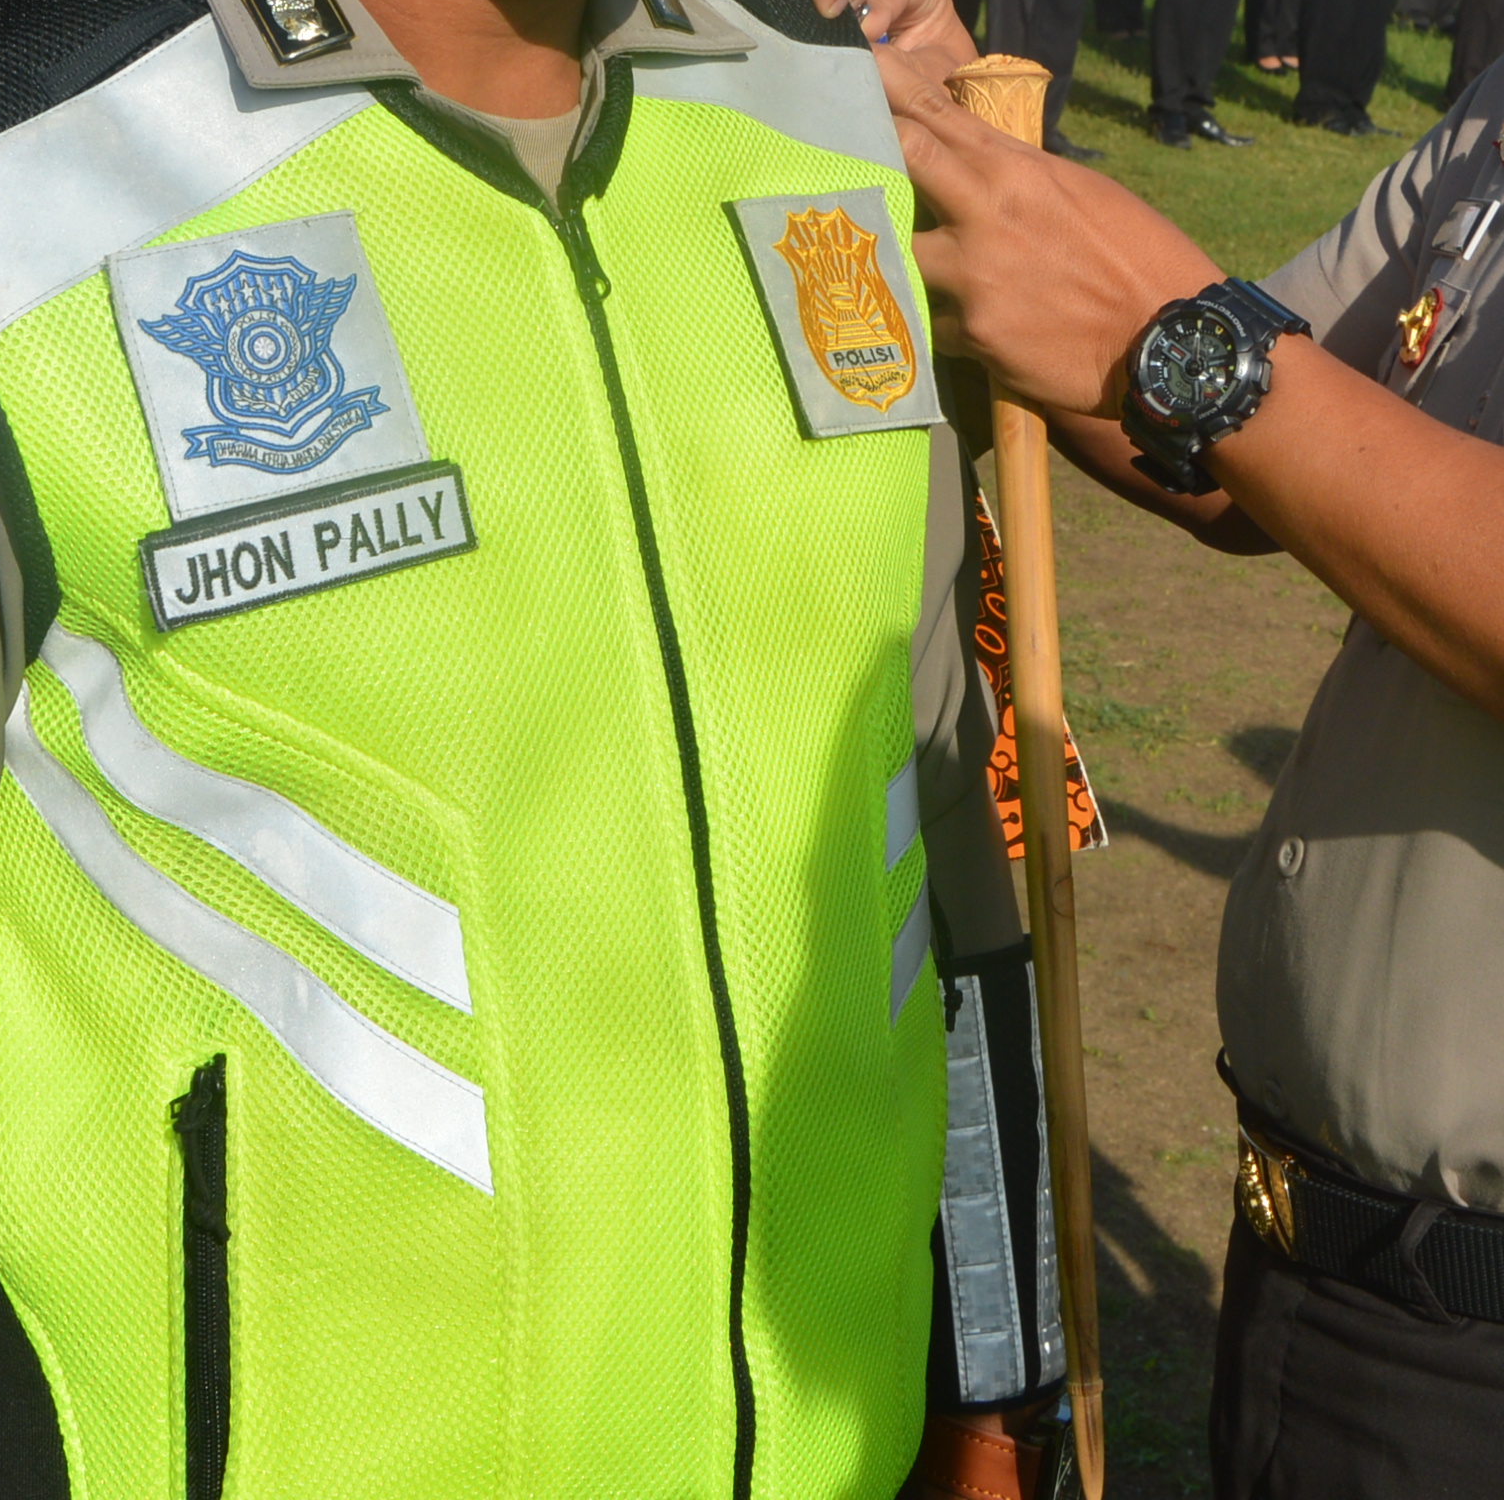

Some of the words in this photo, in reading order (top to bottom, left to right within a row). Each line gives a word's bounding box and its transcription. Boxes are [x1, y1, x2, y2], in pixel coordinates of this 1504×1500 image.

[1196, 299, 1246, 337] PROTECTION
[832, 345, 895, 367] POLISI
[175, 531, 296, 604] JHON
[313, 491, 445, 572] PALLY
